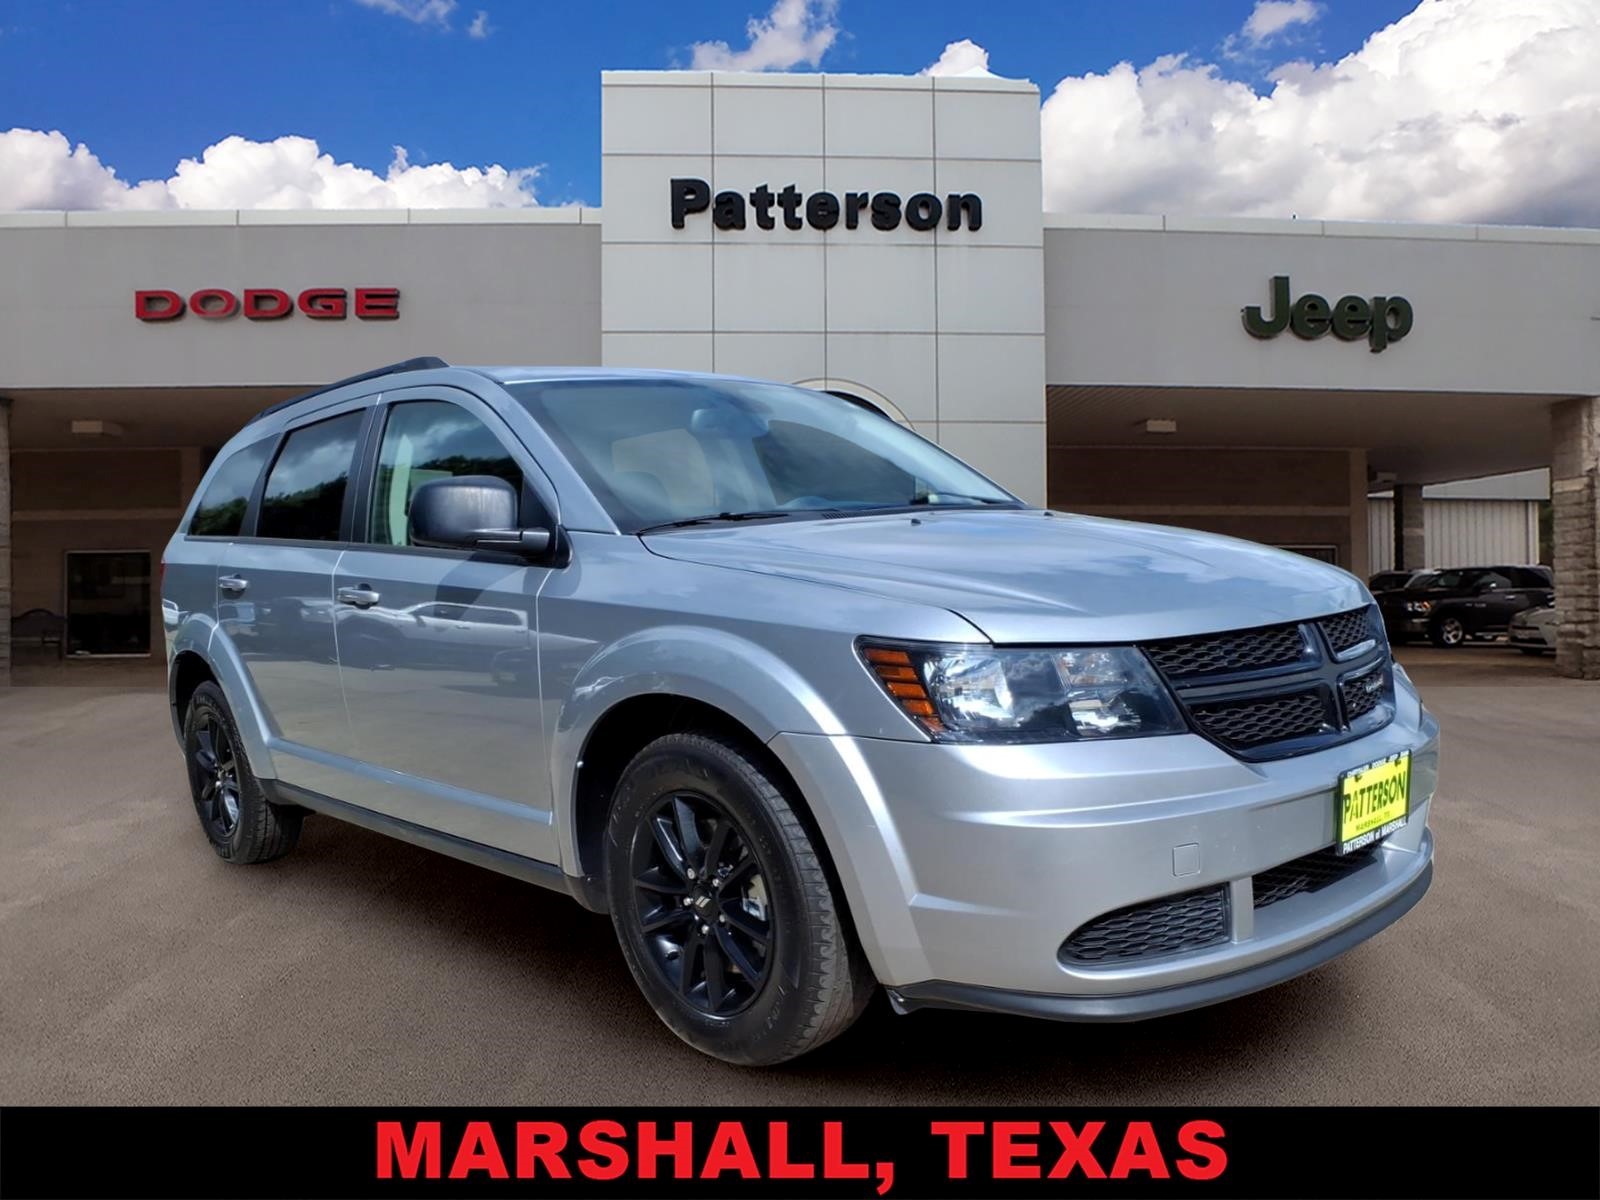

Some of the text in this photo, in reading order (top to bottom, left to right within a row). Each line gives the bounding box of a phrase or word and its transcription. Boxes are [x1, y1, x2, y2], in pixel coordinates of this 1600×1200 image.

[670, 178, 983, 233] Patterson
[134, 287, 398, 321] DODGE
[1240, 275, 1414, 355] Jeep
[1343, 771, 1406, 825] PATTERSON
